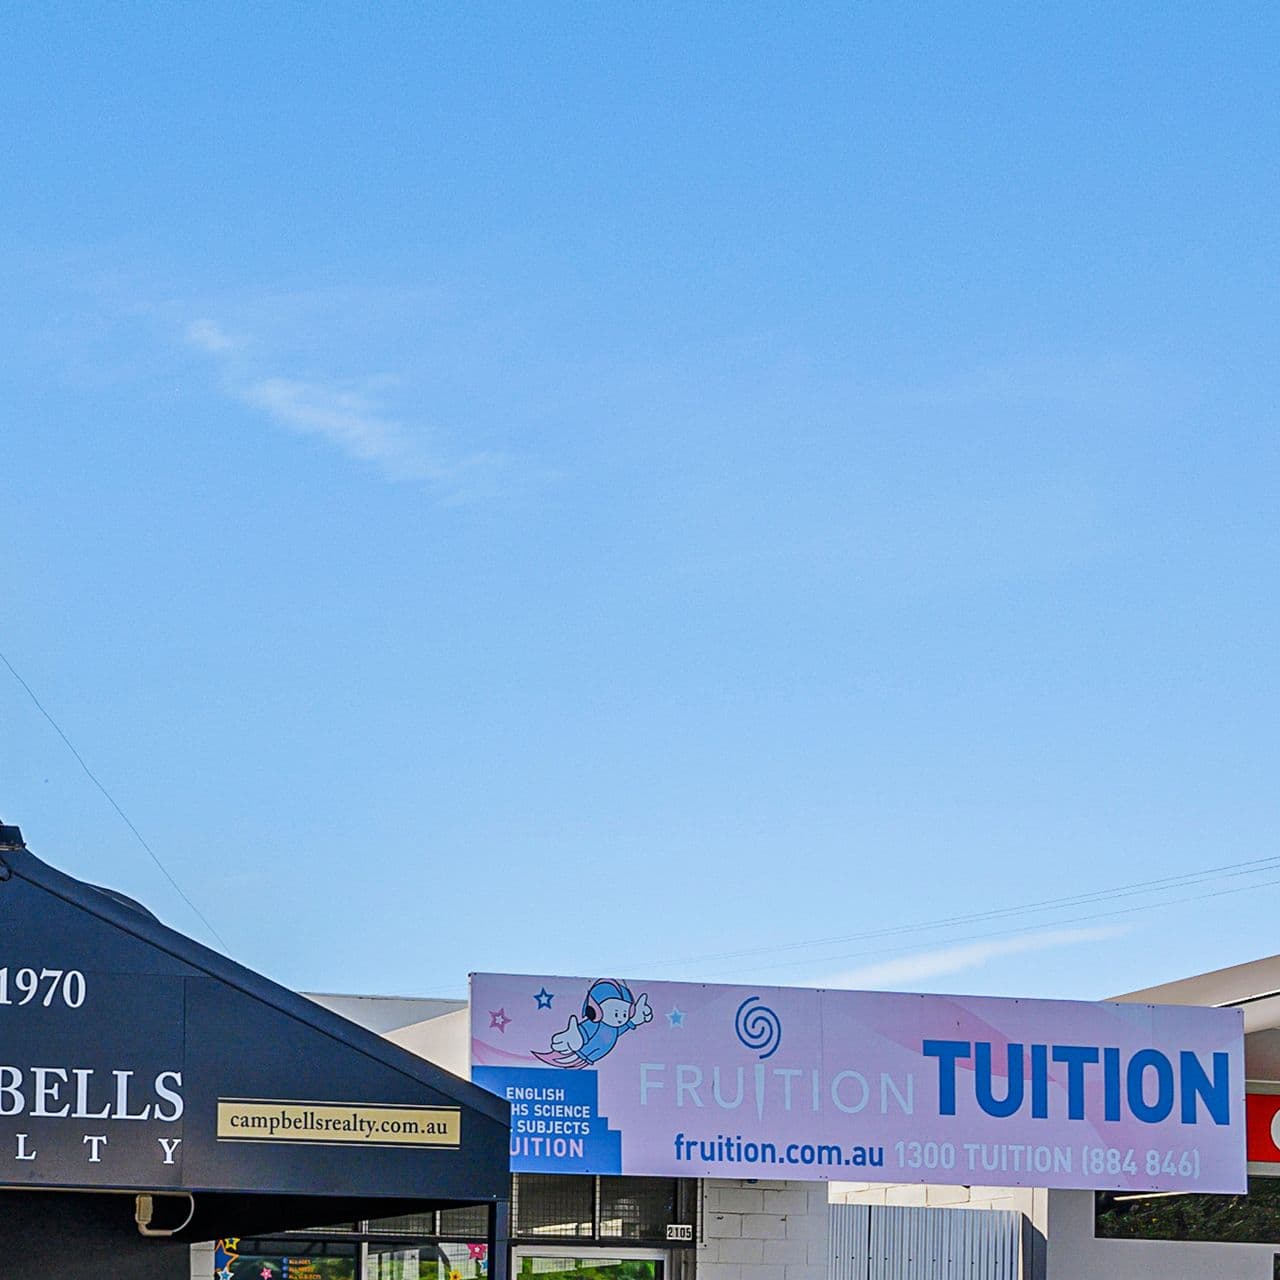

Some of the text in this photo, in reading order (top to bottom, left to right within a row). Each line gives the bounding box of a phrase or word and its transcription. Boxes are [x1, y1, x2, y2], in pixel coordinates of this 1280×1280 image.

[639, 1039, 1230, 1126] FRUITION TUITION
[506, 1086, 565, 1101] ENGLISH
[534, 1104, 591, 1118] SCIENCE
[229, 1110, 448, 1138] campbellsrealty.com.au
[517, 1120, 590, 1135] SUBJECTS
[509, 1136, 584, 1158] UITION
[674, 1132, 1201, 1179] fruition.com.au 1300 TUITION (884 846)
[667, 1225, 692, 1238] 2105
